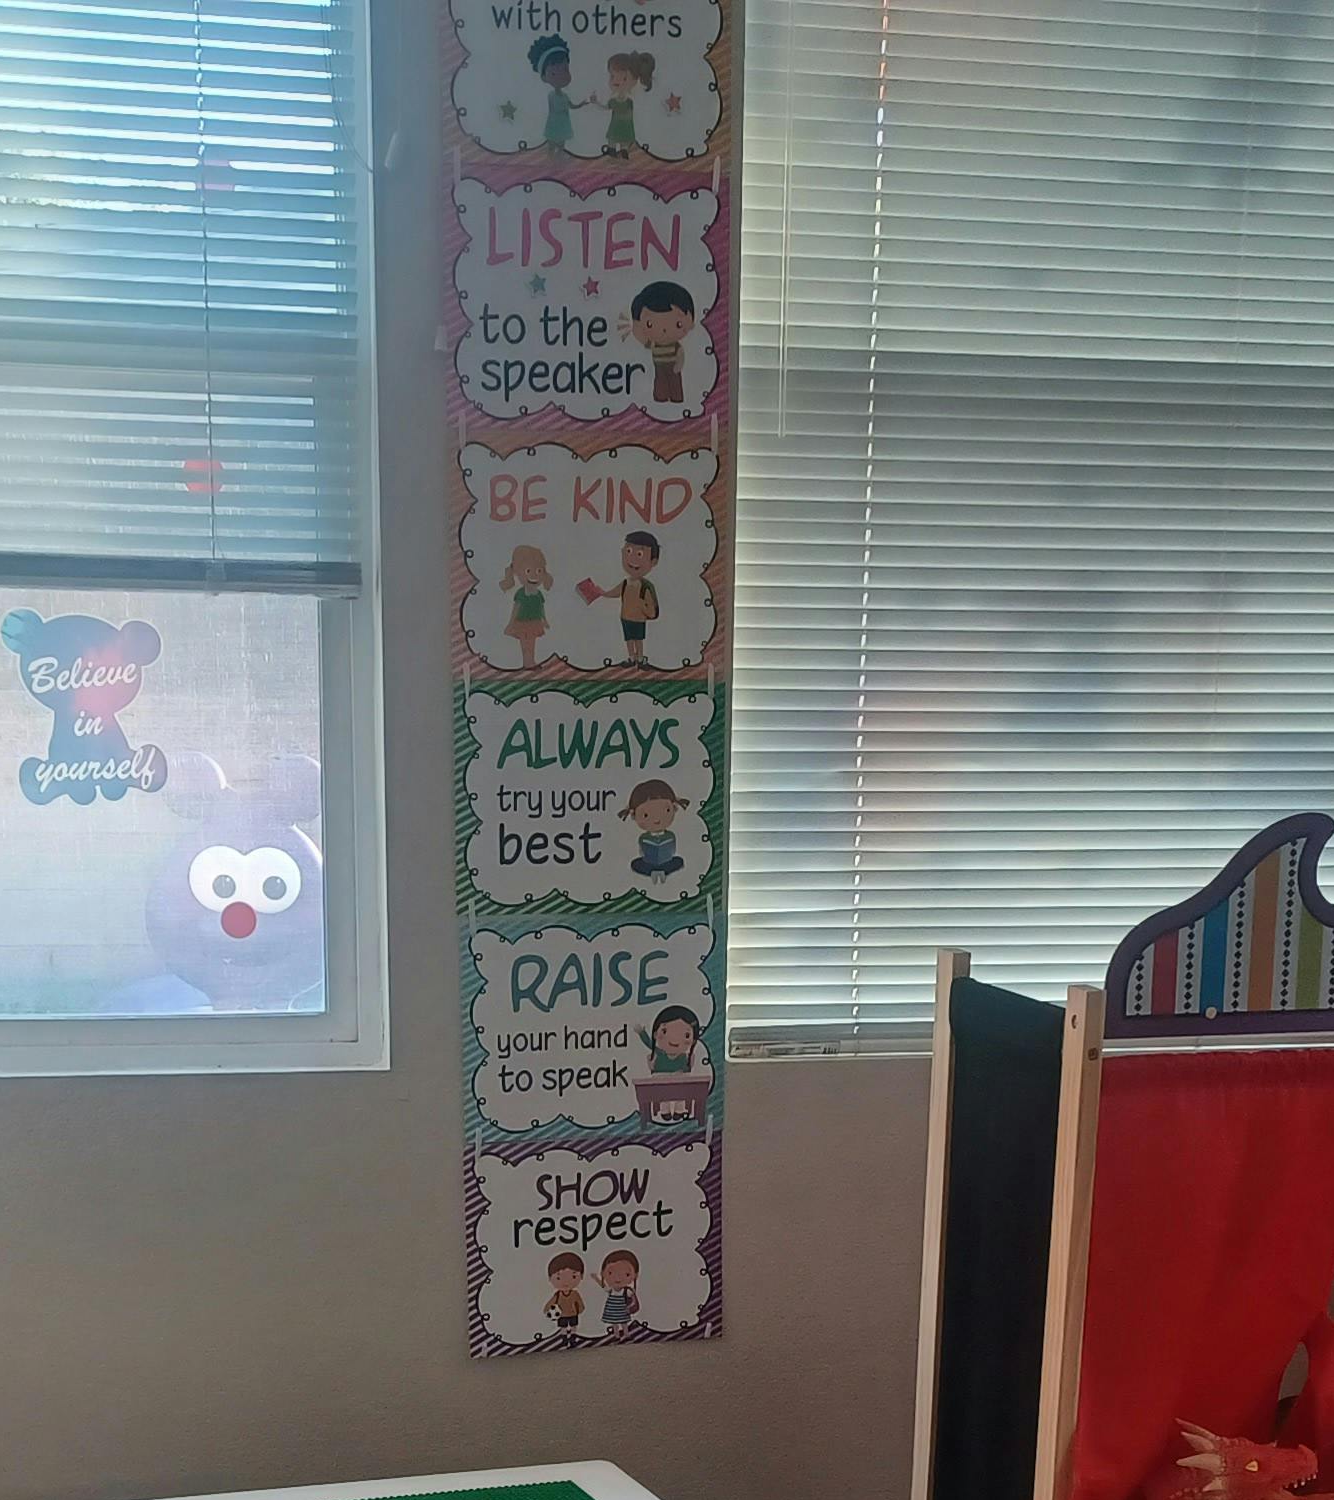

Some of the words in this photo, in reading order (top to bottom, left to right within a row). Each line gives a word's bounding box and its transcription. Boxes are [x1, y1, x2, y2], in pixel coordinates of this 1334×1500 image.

[492, 5, 562, 33] with
[572, 8, 683, 37] others
[486, 206, 681, 272] LISTEN
[479, 303, 526, 345] to
[540, 305, 608, 347] the
[481, 352, 645, 402] speaker
[489, 474, 547, 522] BE
[573, 476, 693, 524] KIND
[27, 656, 138, 694] Believe
[73, 711, 103, 737] in
[496, 718, 680, 770] ALWAYS
[35, 746, 156, 793] yourself
[497, 784, 543, 818] try
[551, 789, 616, 818] your
[499, 822, 602, 866] best
[511, 950, 669, 1014] RAISE
[497, 1030, 557, 1059] your
[564, 1024, 628, 1051] hand
[498, 1064, 533, 1093] to
[542, 1059, 629, 1097] speak
[536, 1168, 650, 1212] SHOW
[513, 1200, 674, 1252] respect
